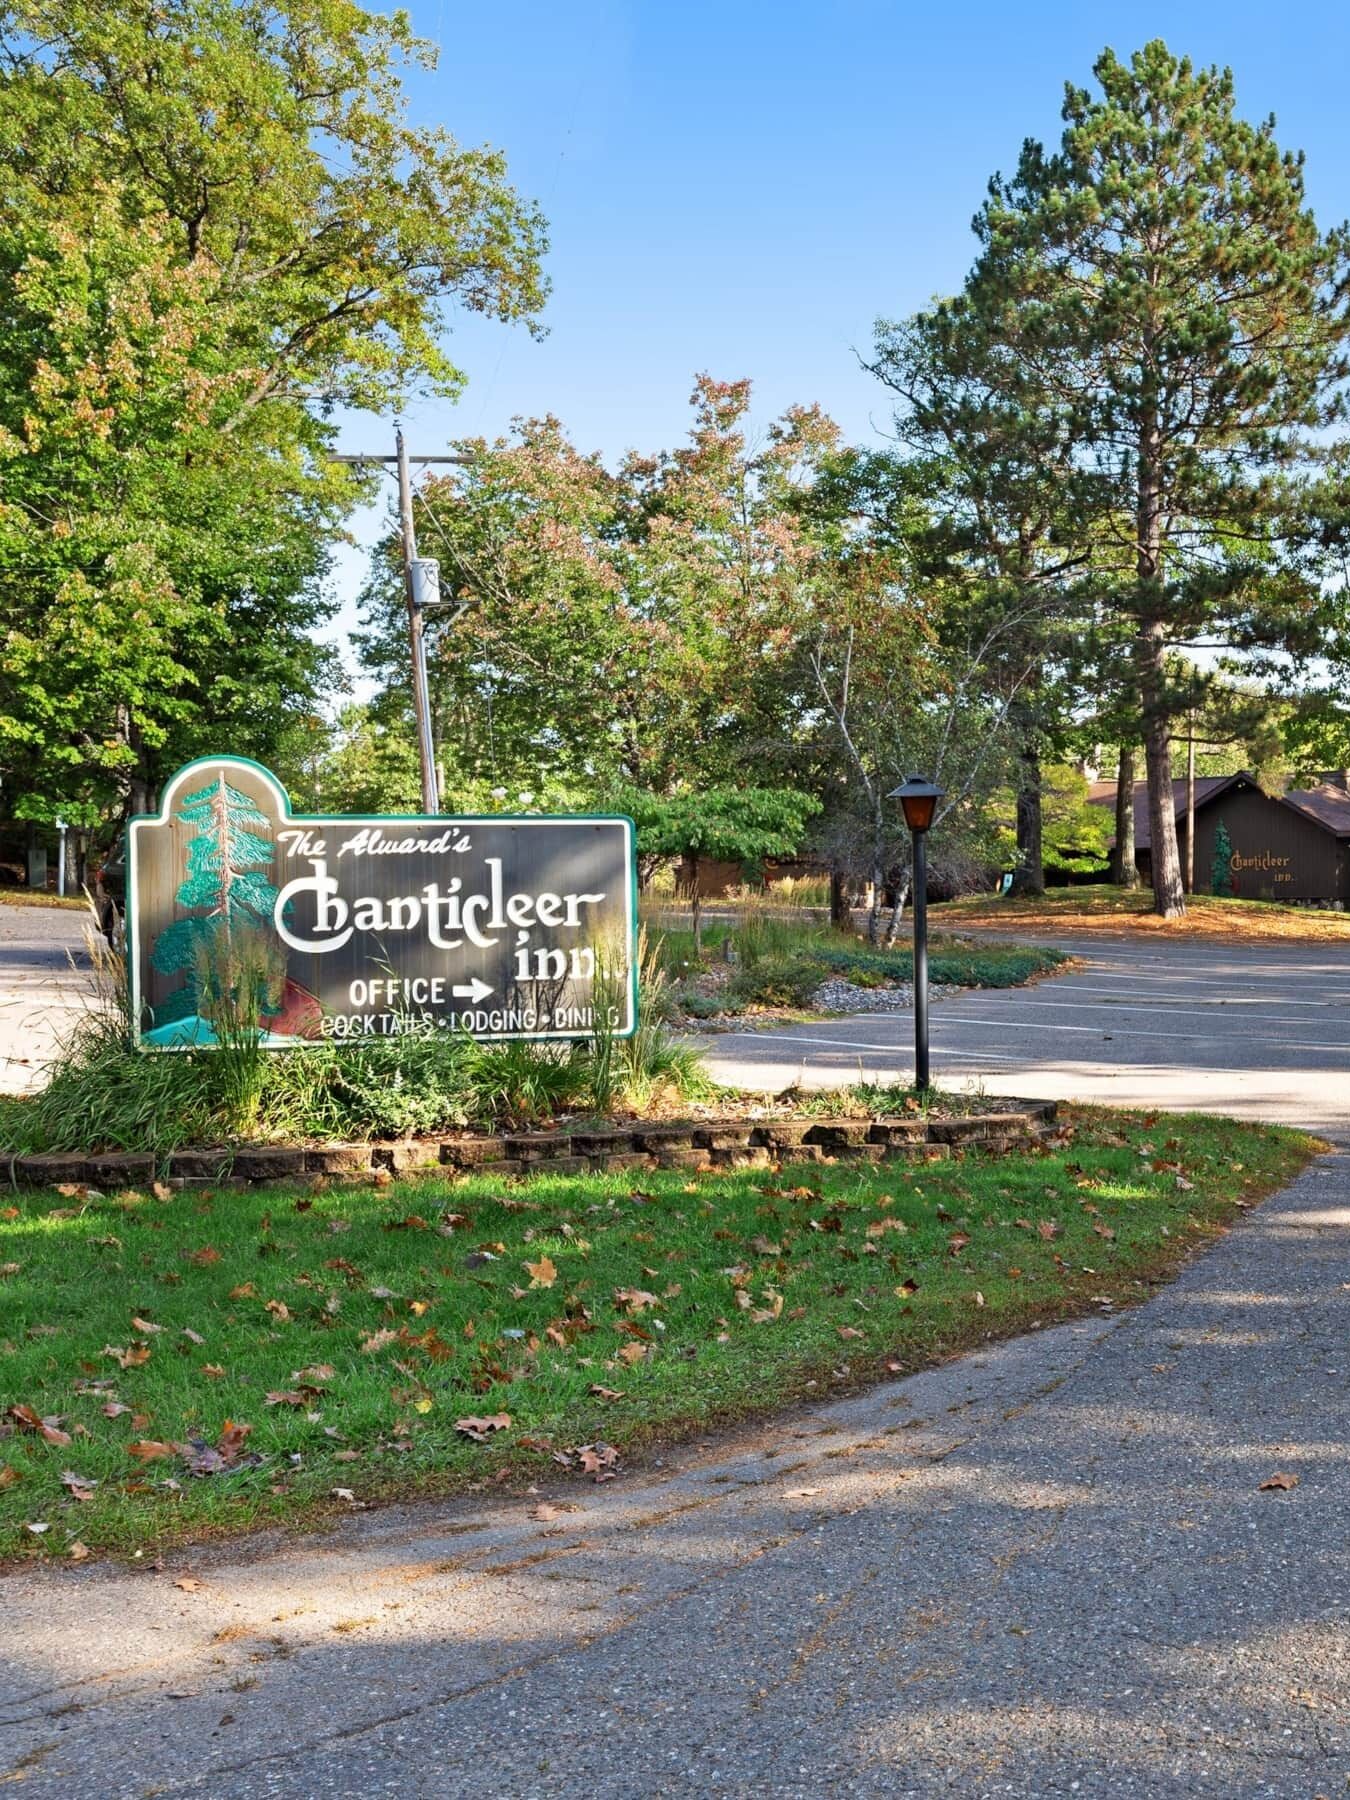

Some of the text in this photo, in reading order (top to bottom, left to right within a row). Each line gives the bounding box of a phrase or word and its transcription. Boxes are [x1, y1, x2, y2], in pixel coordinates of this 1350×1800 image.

[278, 828, 472, 857] The Alward's
[1231, 849, 1289, 870] Chanticleer
[274, 858, 606, 953] Chanticleer
[349, 977, 446, 1007] OFFICE
[451, 1008, 537, 1033] LODGING
[554, 1006, 620, 1029] DINIG
